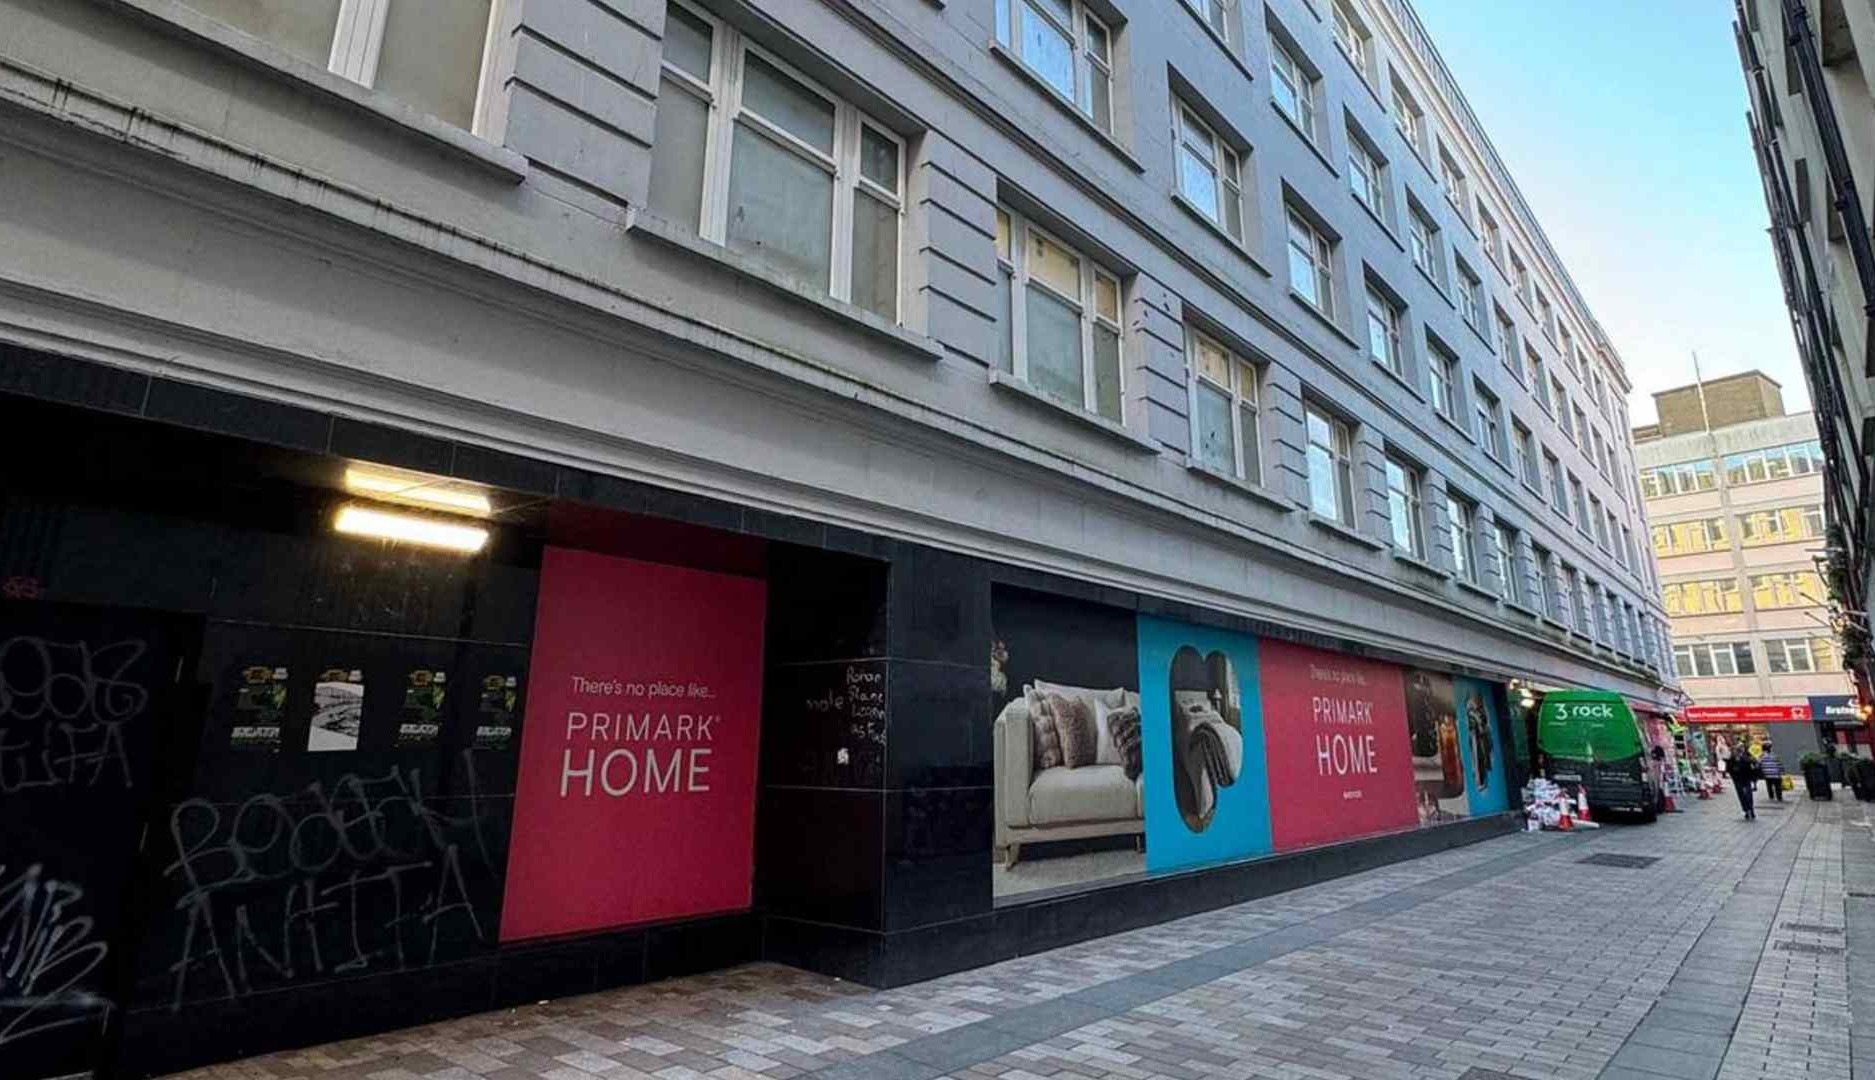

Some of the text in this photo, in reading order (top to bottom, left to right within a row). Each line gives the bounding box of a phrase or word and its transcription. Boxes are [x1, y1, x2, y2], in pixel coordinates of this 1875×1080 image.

[572, 676, 622, 695] There's
[626, 683, 645, 696] no
[649, 681, 685, 700] place
[1313, 696, 1373, 725] PRIMARK
[1554, 703, 1614, 720] 3 rock
[1316, 734, 1377, 776] HOME
[560, 748, 712, 797] HOME
